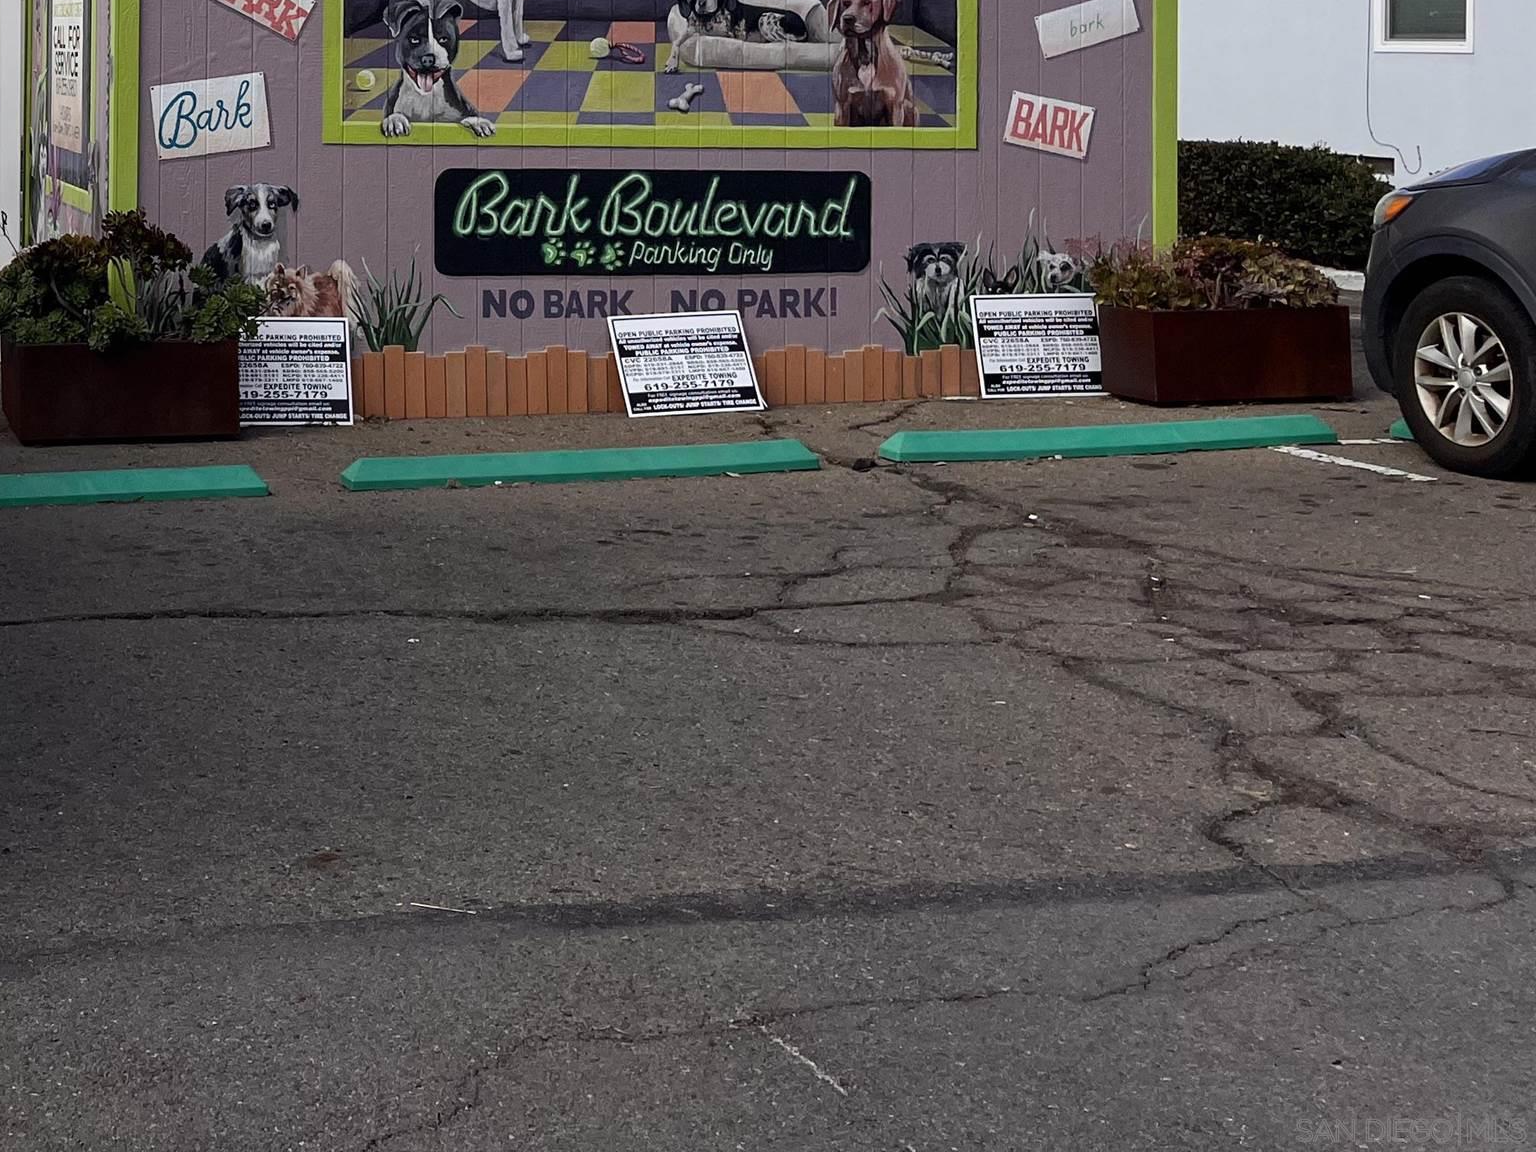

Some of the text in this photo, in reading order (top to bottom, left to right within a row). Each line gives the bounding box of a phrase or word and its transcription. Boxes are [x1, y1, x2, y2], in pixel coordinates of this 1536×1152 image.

[54, 25, 80, 49] CALL FOR
[1070, 14, 1104, 37] bark
[55, 51, 78, 77] SERVICE
[159, 80, 252, 149] Bark
[1010, 98, 1089, 152] BARK
[455, 172, 856, 237] Bark Boulevard
[629, 241, 773, 272] Parking Only
[482, 289, 535, 319] NO
[671, 288, 726, 312] NO
[737, 287, 837, 318] PARK!
[665, 328, 694, 336] PARKING
[697, 326, 736, 334] PROHIBITED
[691, 346, 729, 354] PROHIBITED
[1000, 364, 1086, 372] 619-255-7179
[644, 380, 735, 391] 619-255-7179
